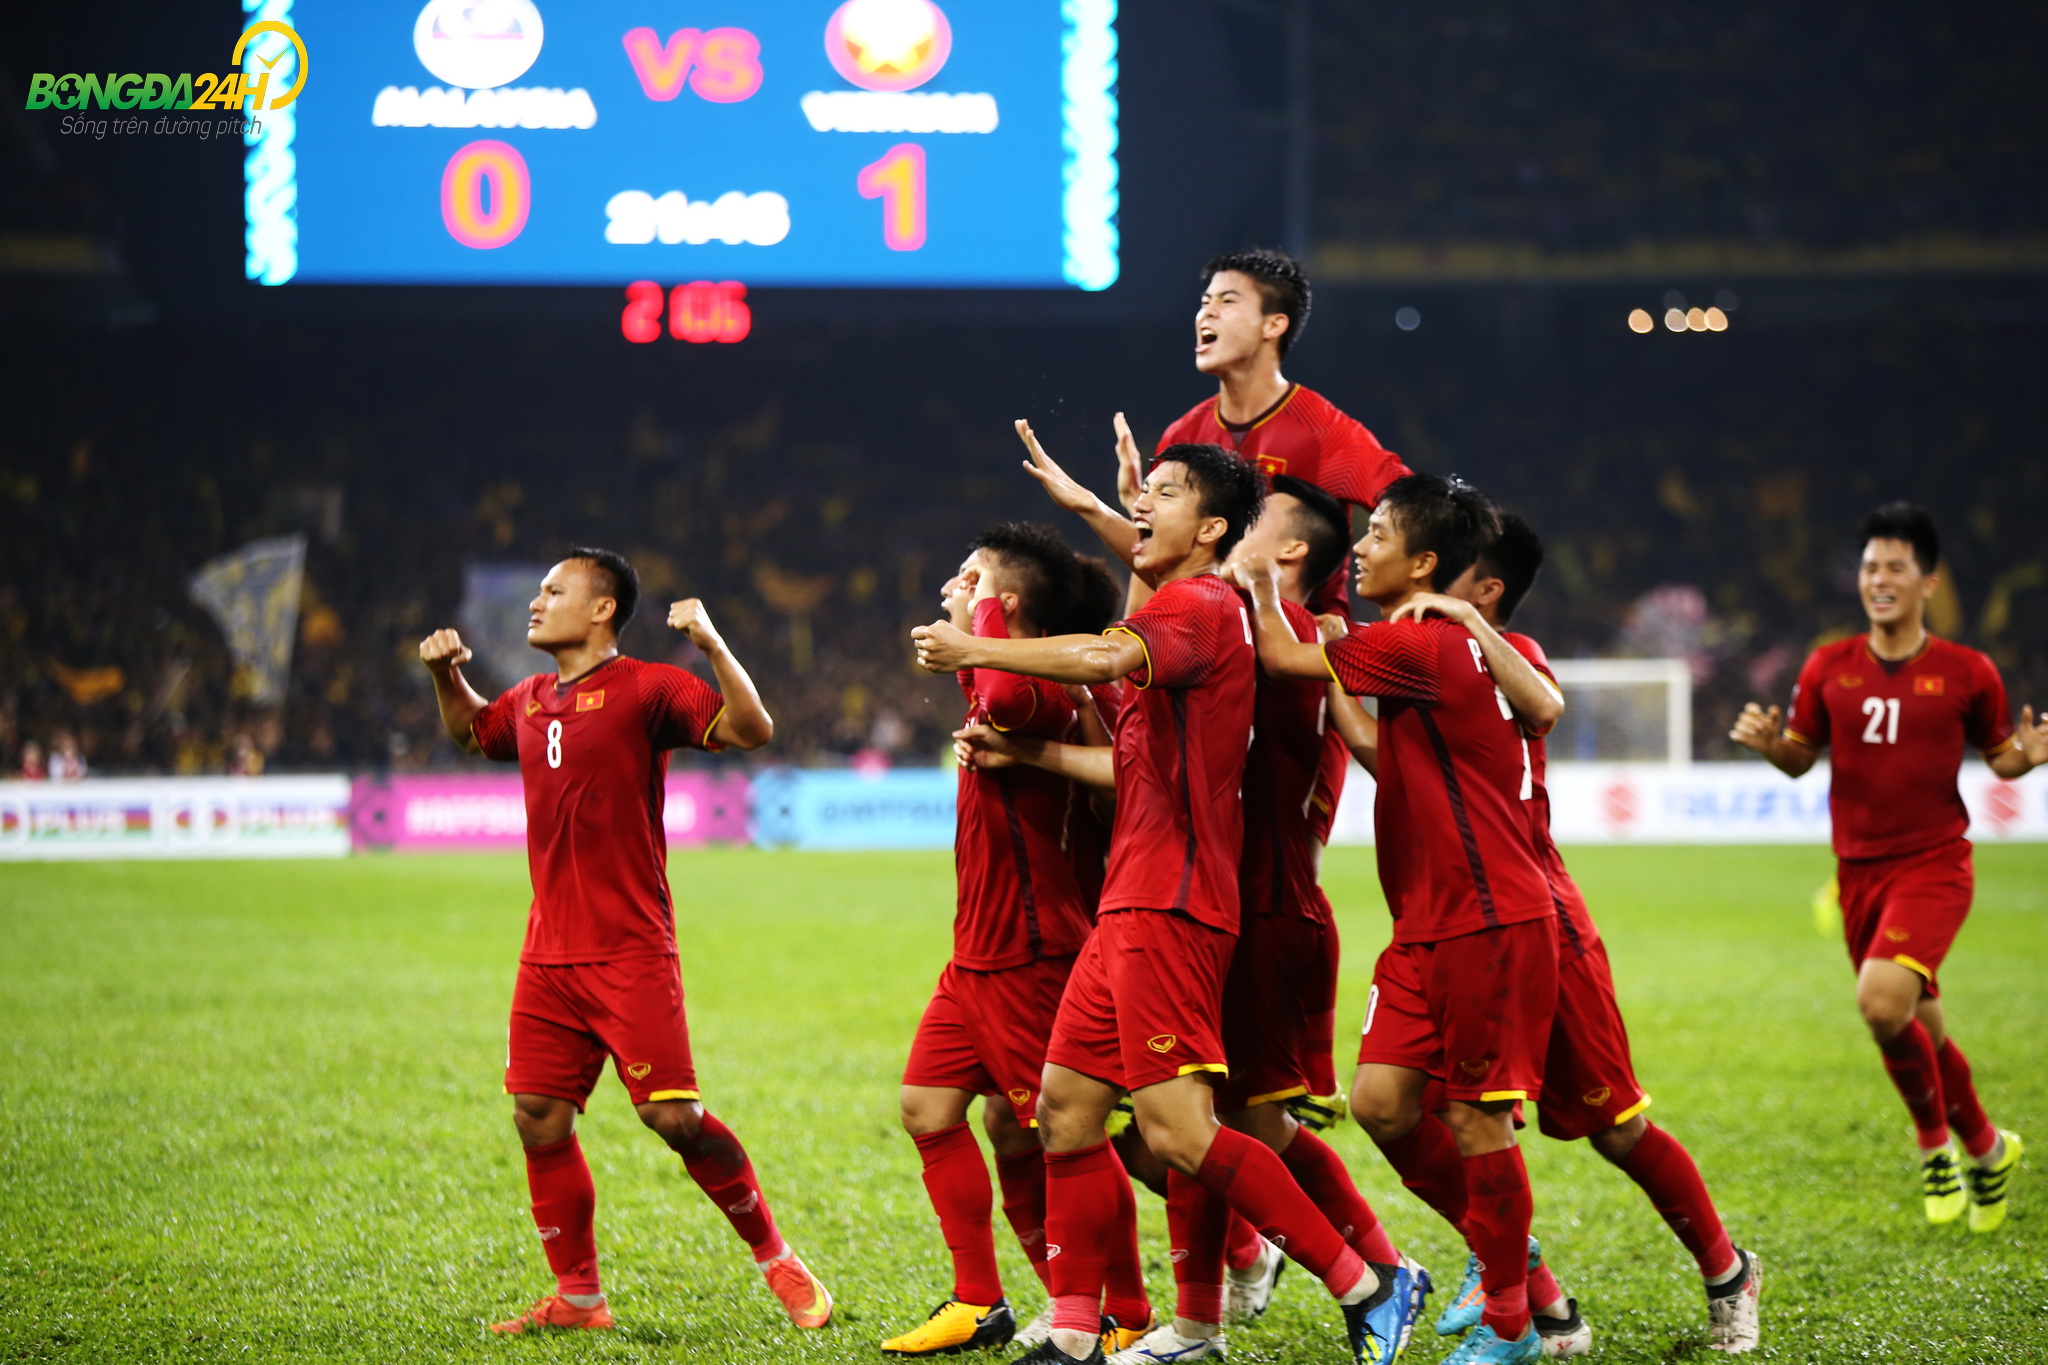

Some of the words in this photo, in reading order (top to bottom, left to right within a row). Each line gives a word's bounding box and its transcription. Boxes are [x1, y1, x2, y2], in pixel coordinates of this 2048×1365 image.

[440, 140, 531, 250] 0
[857, 142, 926, 252] 1
[546, 719, 563, 769] 8
[1862, 696, 1900, 745] 21
